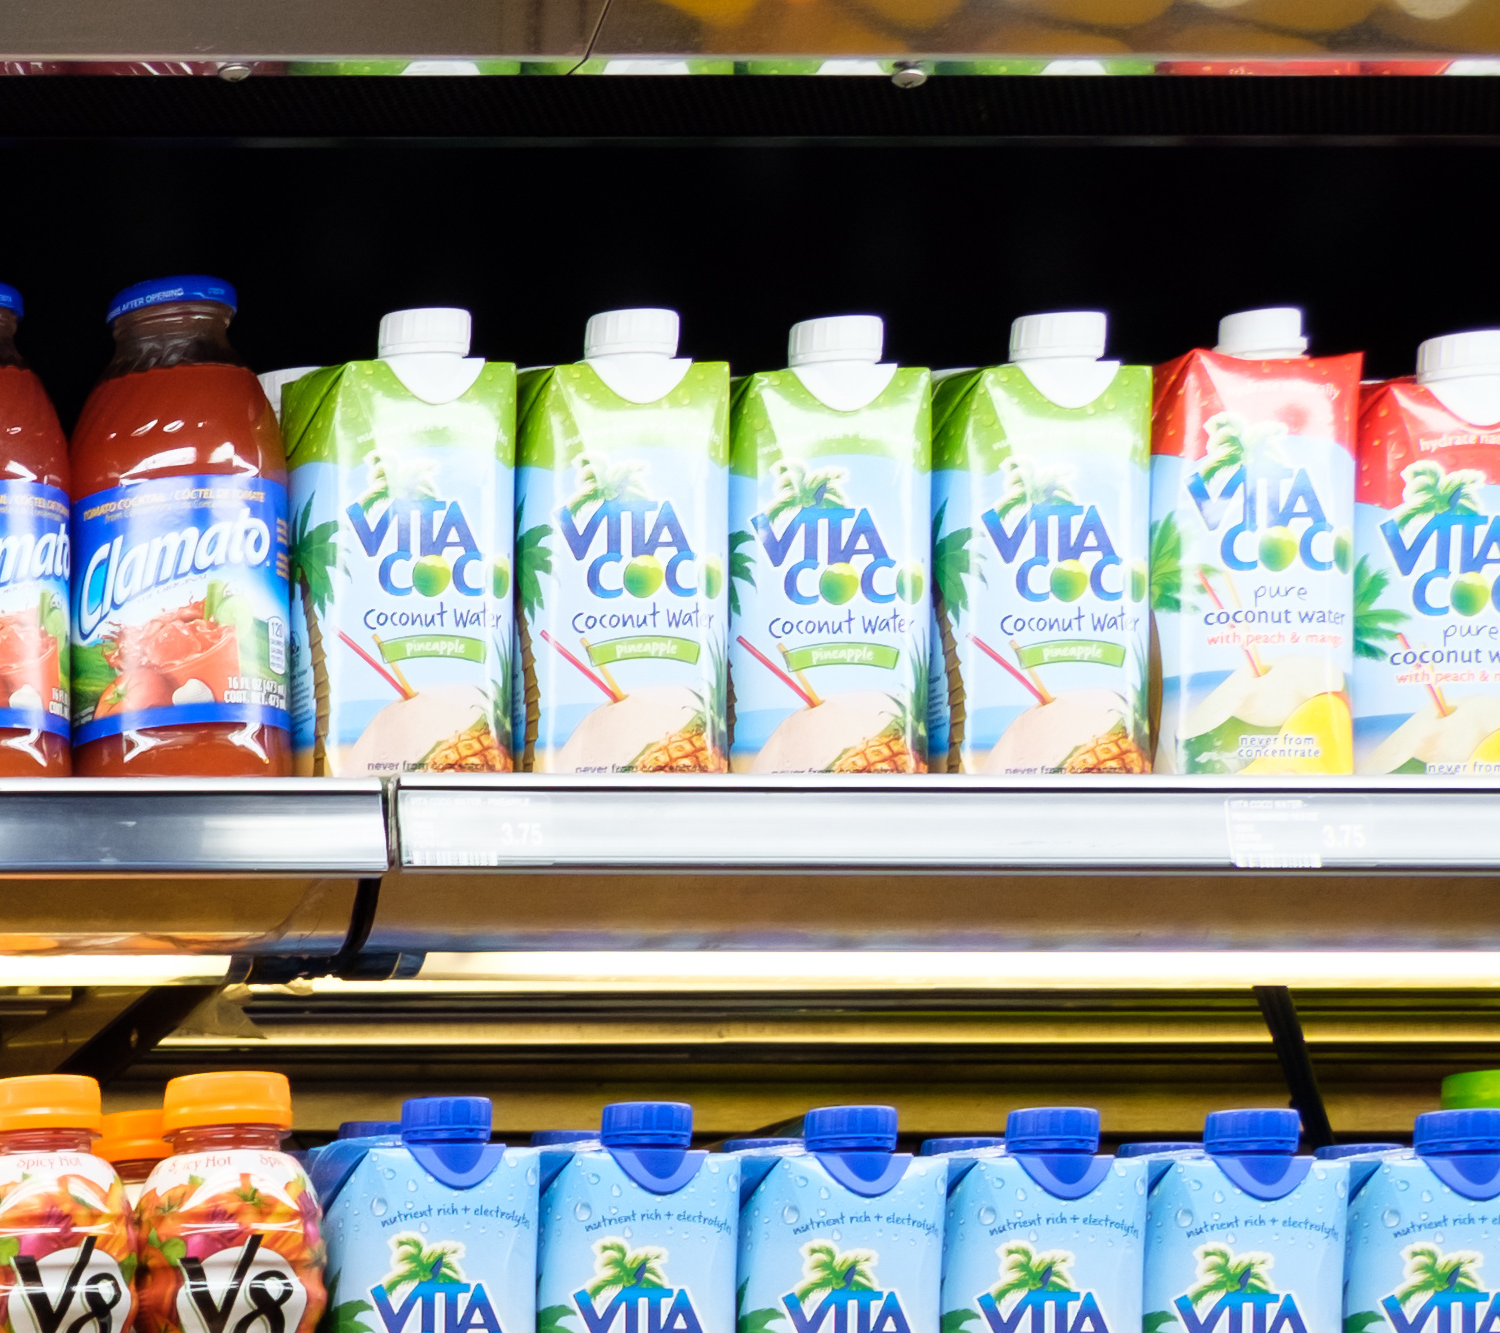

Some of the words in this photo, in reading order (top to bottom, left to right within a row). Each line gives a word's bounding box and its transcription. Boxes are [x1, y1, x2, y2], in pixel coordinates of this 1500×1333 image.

[552, 500, 692, 559] VITA
[1254, 584, 1307, 601] pure
[1204, 608, 1292, 626] coconut
[1298, 608, 1345, 626] water
[1207, 630, 1242, 647] with
[1246, 631, 1285, 648] peach
[615, 639, 678, 658] pineapple
[437, 1206, 459, 1220] rich
